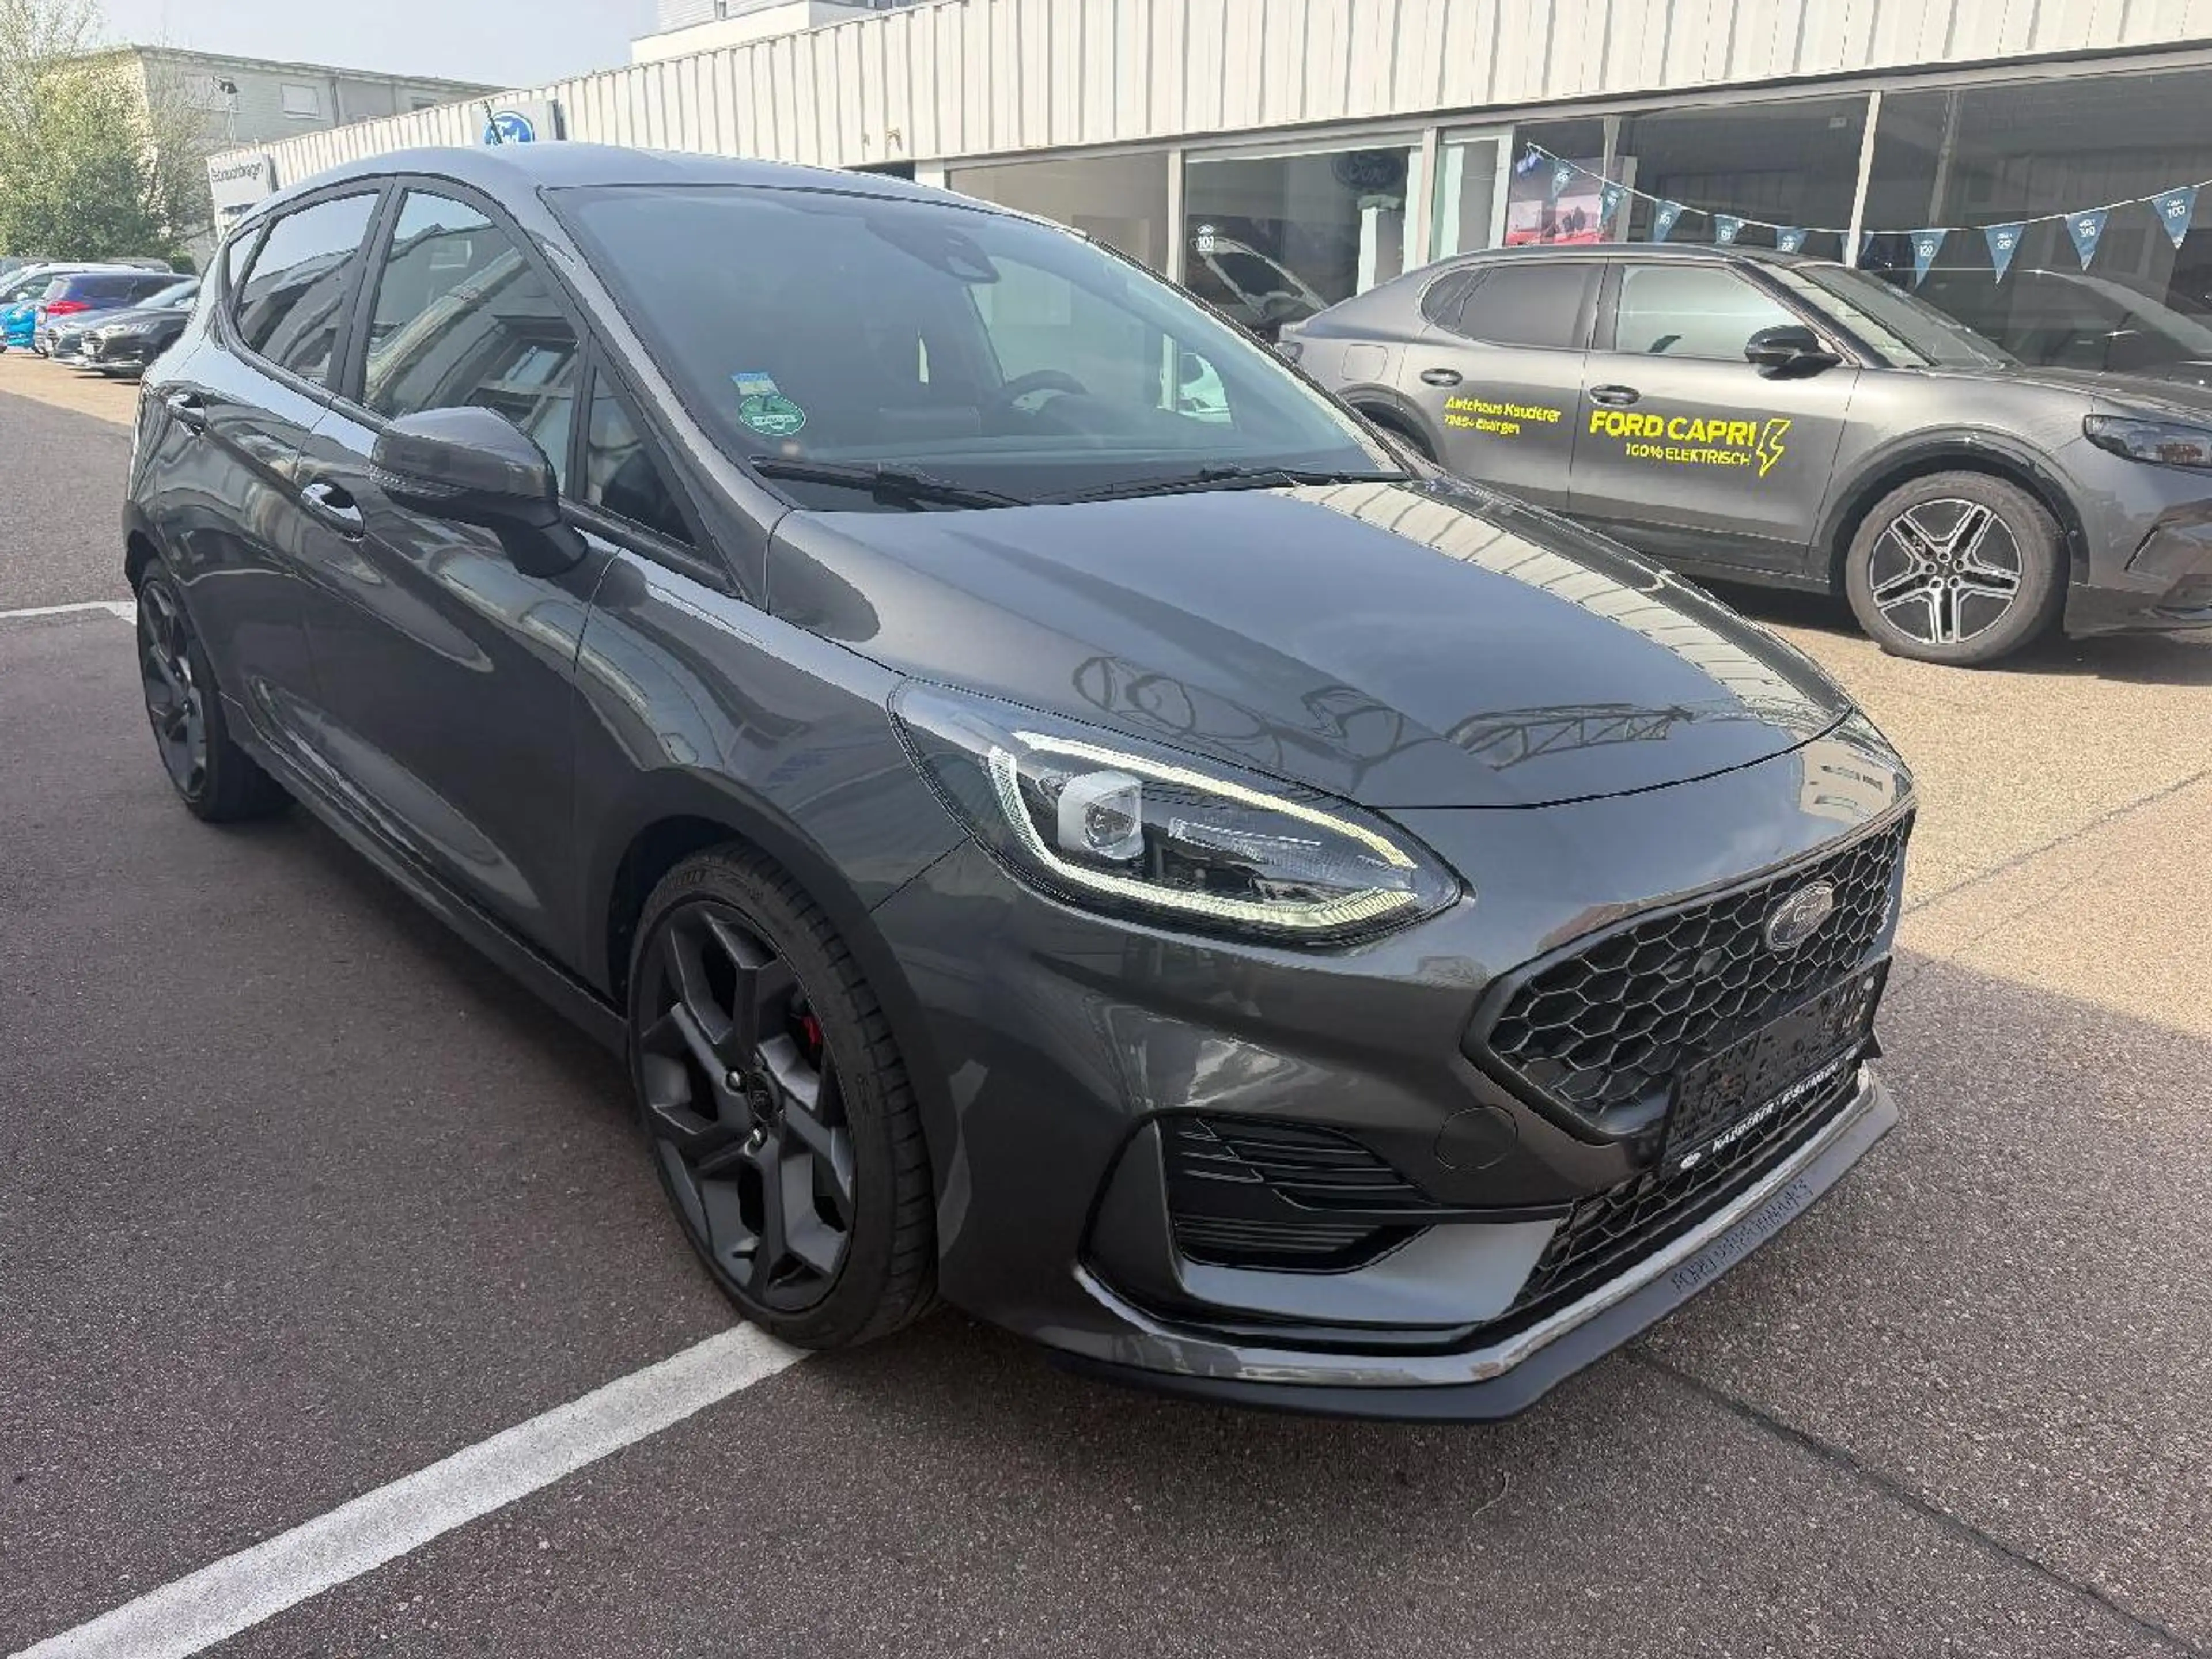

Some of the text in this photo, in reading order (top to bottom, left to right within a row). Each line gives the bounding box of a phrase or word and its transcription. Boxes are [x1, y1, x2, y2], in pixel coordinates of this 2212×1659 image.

[1504, 403, 1561, 422] Kauderer
[1589, 410, 1758, 447] FORD CAPRI
[1626, 442, 1751, 467] 100% ELEKTRISCH
